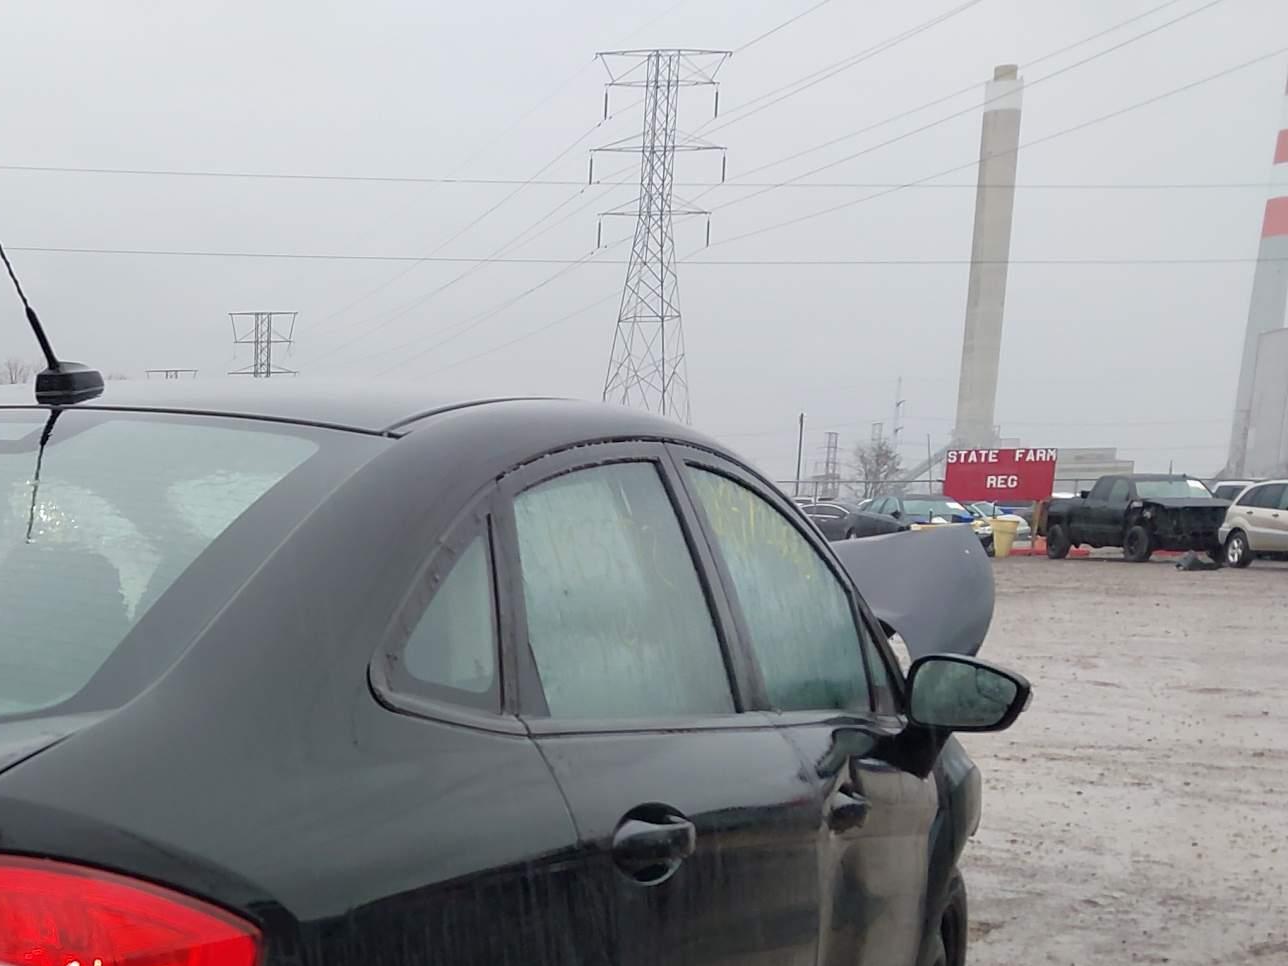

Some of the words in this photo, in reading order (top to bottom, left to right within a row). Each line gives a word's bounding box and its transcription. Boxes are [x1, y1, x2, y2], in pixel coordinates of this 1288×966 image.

[948, 450, 999, 463] STATE
[1015, 449, 1057, 462] FARM
[986, 475, 1018, 489] REG
